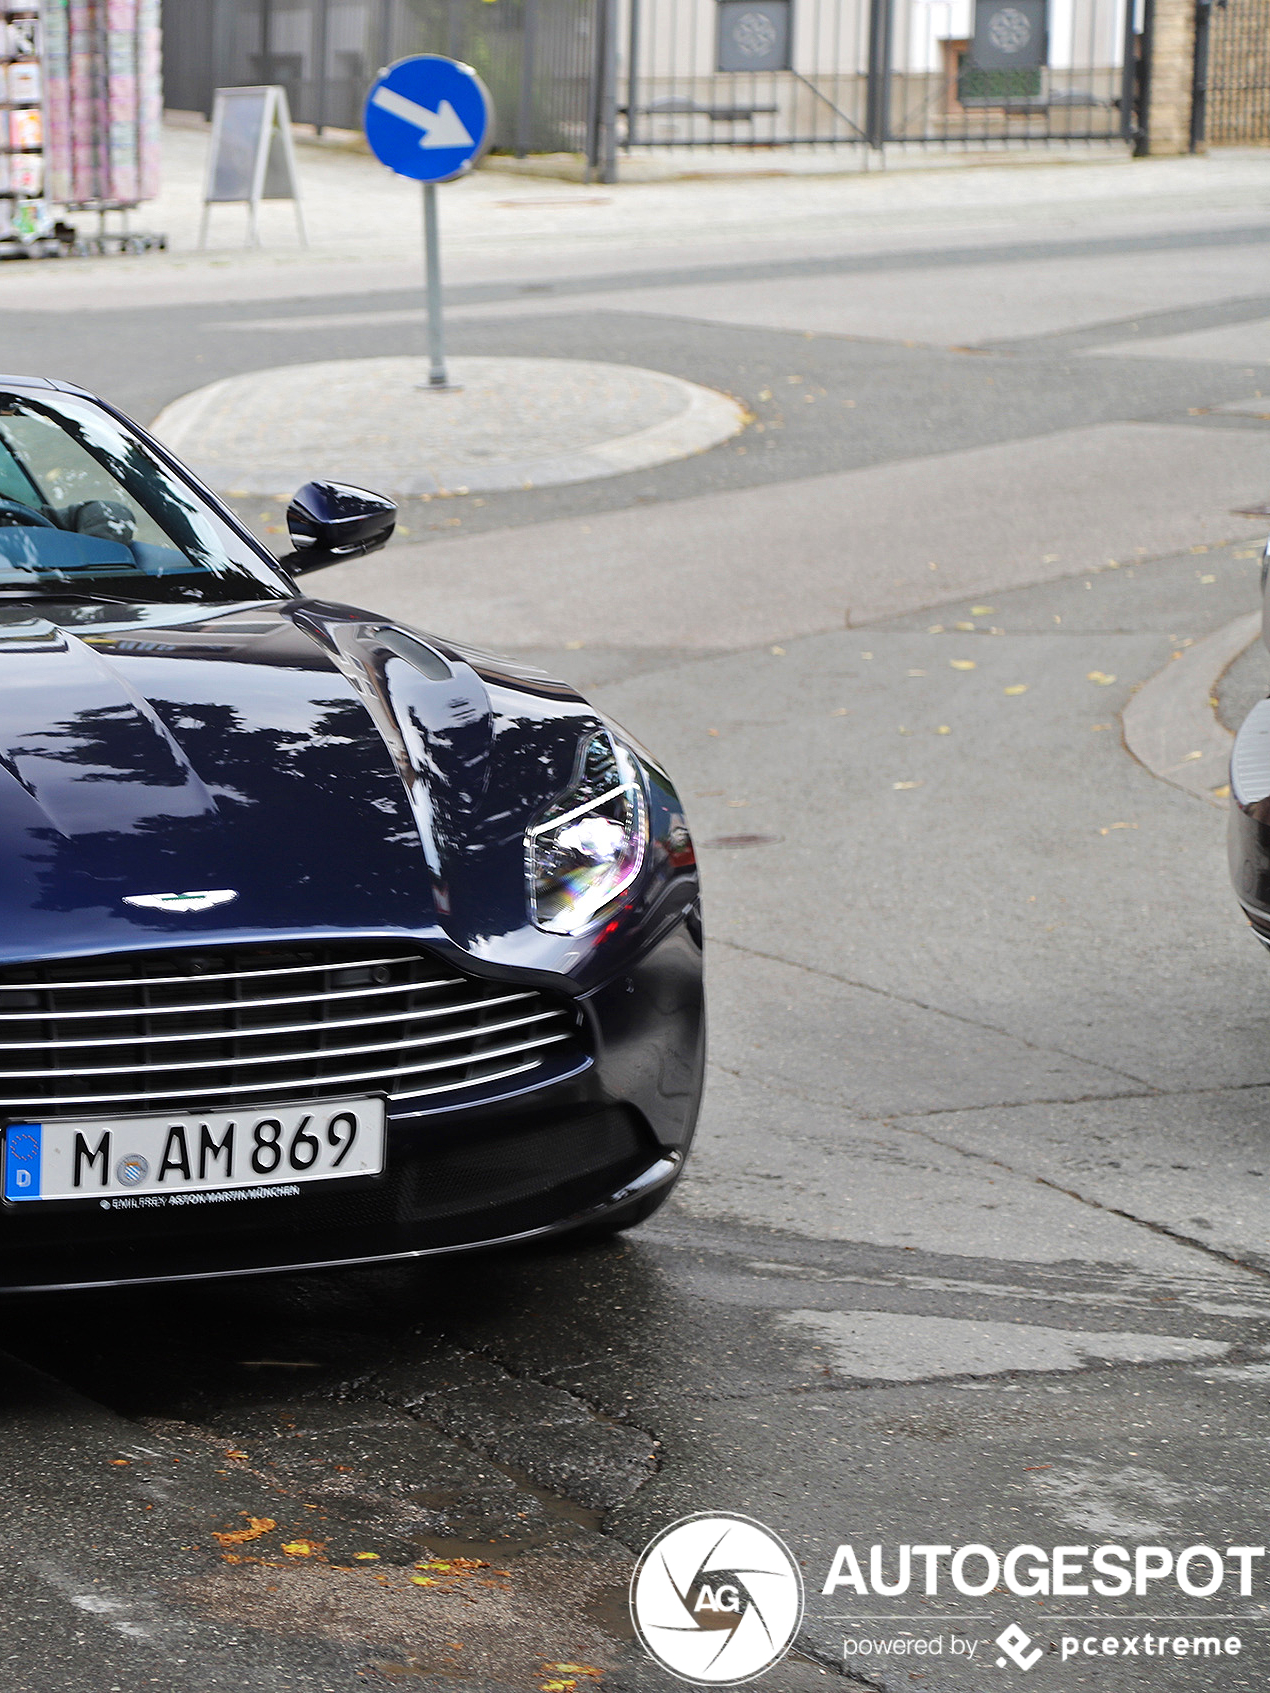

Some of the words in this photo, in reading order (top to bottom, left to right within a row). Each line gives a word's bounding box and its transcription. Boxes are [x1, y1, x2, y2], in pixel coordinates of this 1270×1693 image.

[73, 1130, 112, 1188] M
[251, 1111, 358, 1175] 869
[139, 1195, 168, 1209] FREY
[168, 1192, 206, 1207] ASTON
[206, 1189, 248, 1204] MARTIN
